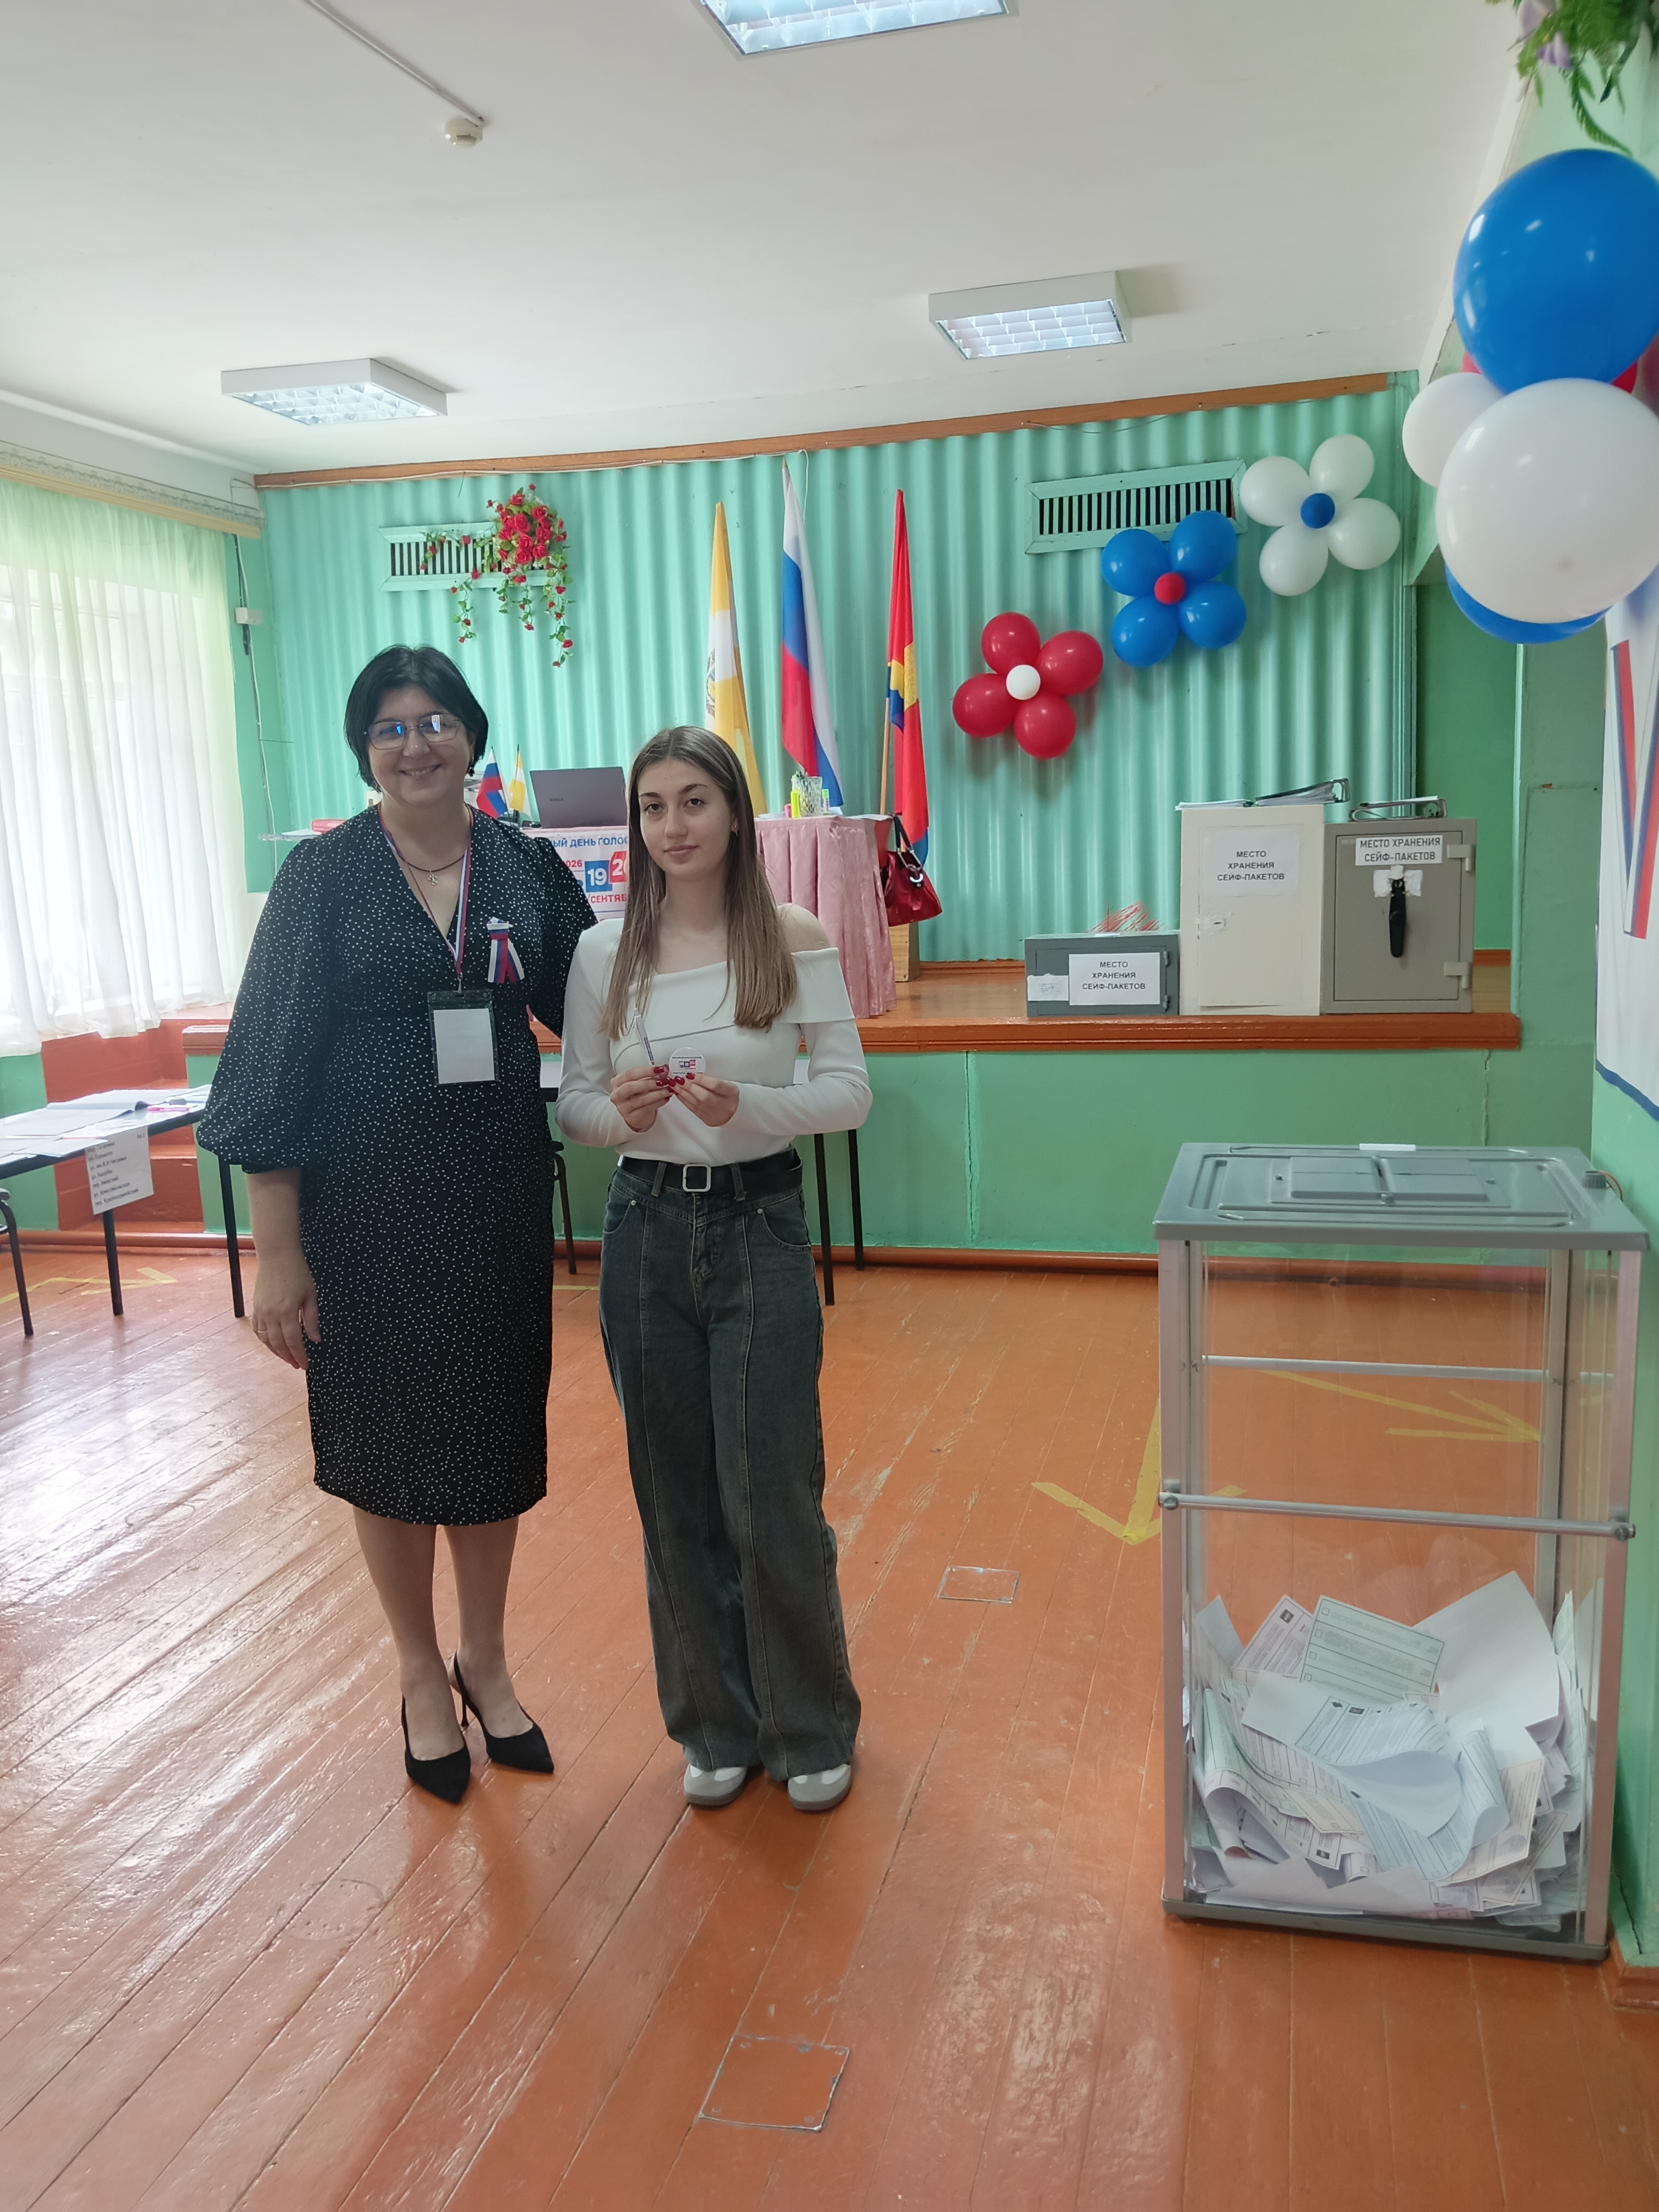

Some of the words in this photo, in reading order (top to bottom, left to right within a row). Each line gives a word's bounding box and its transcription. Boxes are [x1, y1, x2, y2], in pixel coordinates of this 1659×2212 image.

[570, 838, 596, 848] ДЕНЬ
[1360, 839, 1390, 848] МЕСТО
[1392, 837, 1441, 847] ХРАНЕНИЯ
[1364, 851, 1436, 862] СЕЙФ-ПАКЕТОВ
[588, 868, 607, 886] 19
[1217, 872, 1285, 881] СЕЙФ-ПАКЕТОВ
